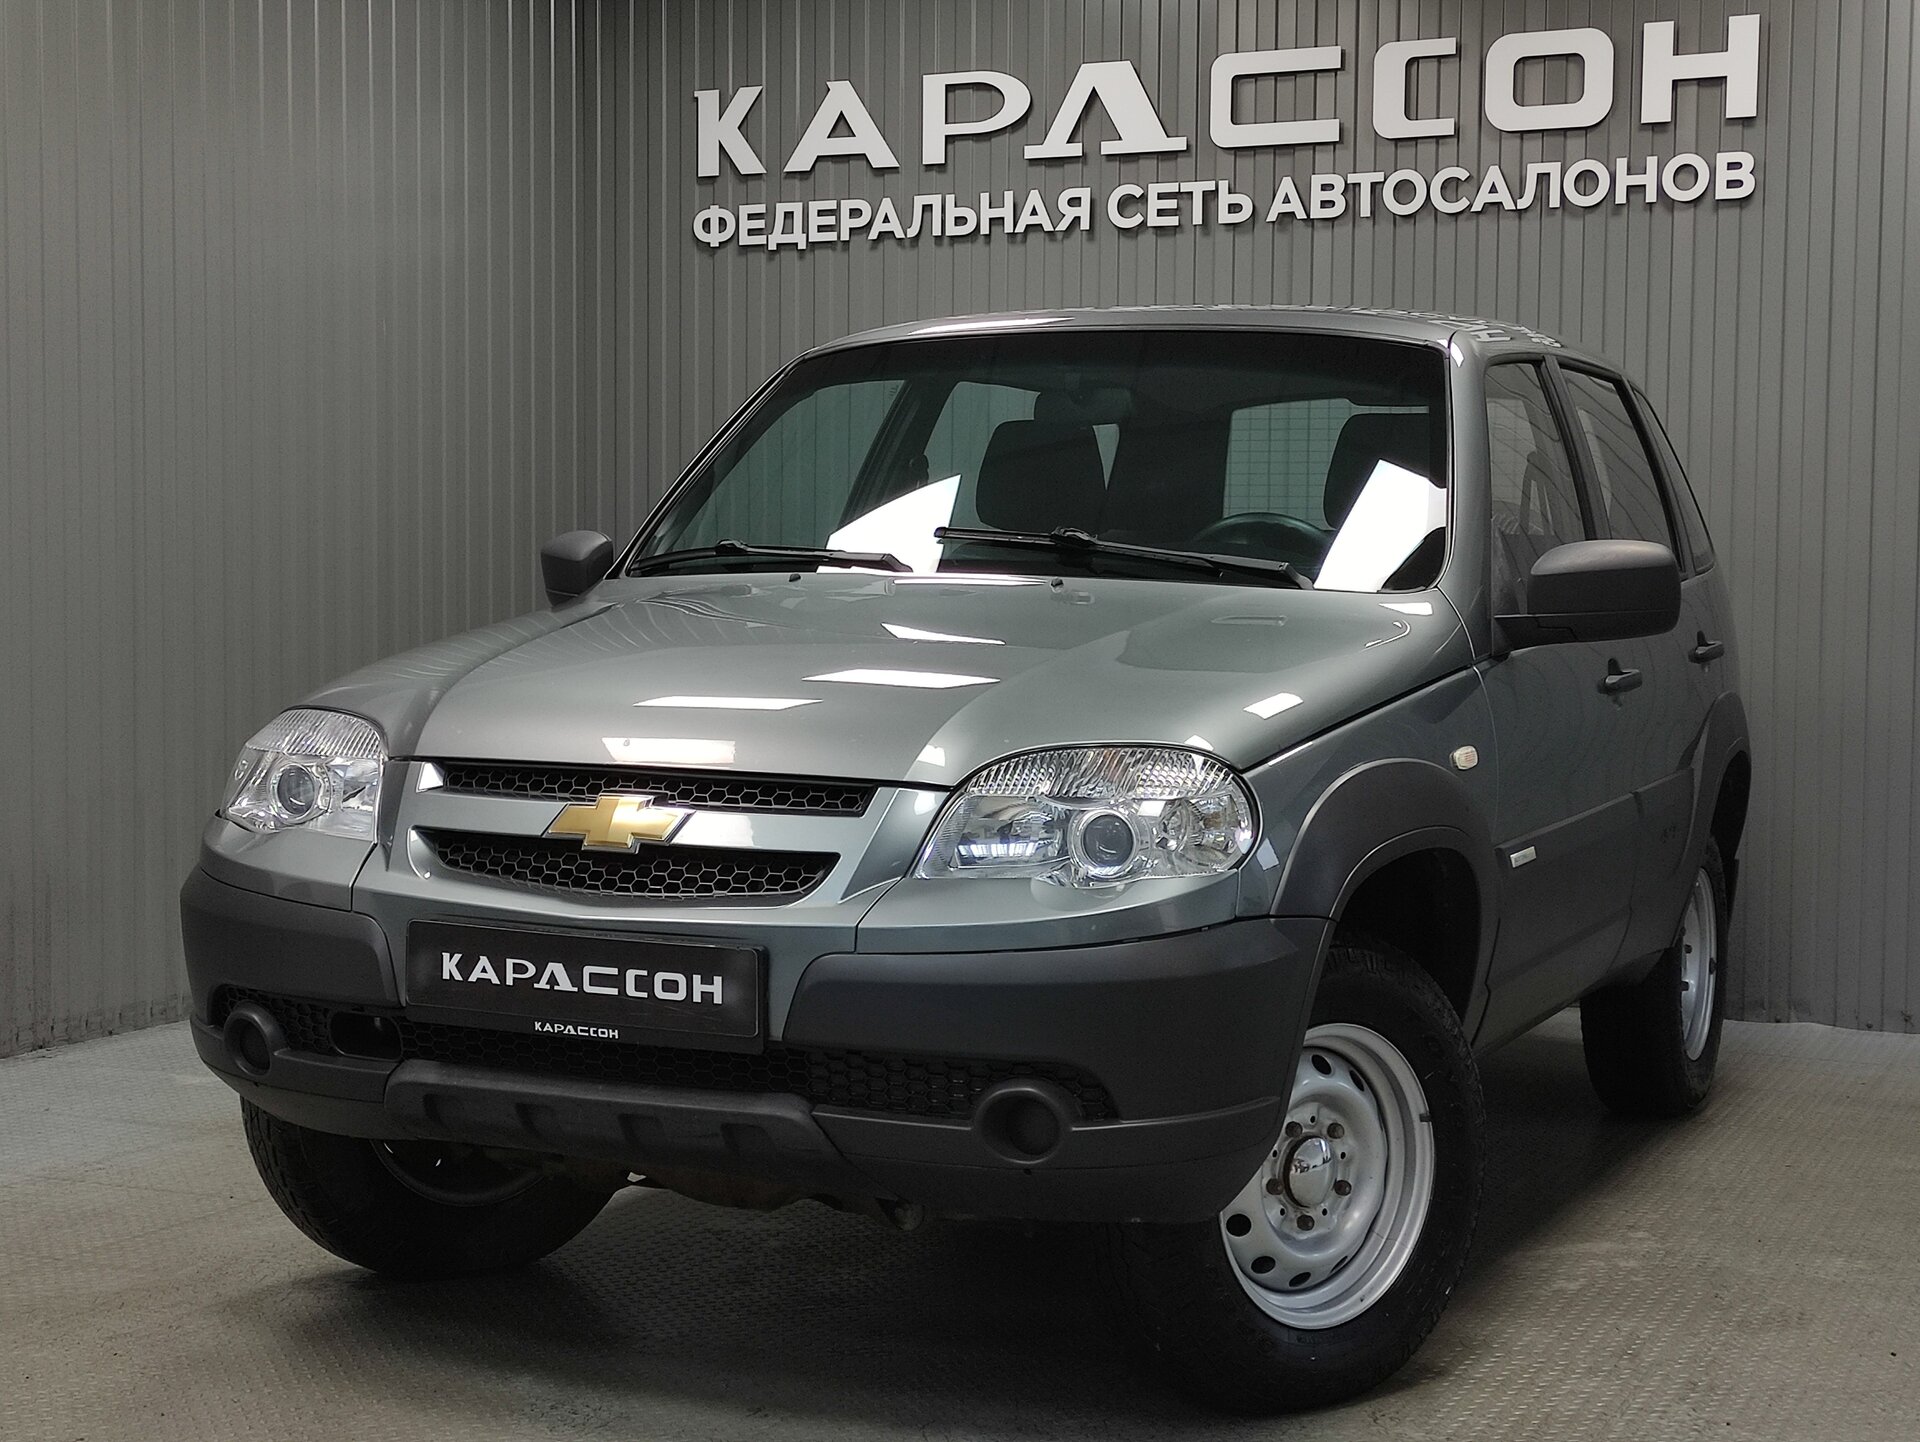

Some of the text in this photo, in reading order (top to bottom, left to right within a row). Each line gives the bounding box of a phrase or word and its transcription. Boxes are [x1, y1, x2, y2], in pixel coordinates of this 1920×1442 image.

[693, 151, 1757, 250] ФЕДЕРАЛЬНАЯ СЕТЬ АВТОСАЛОНОВ
